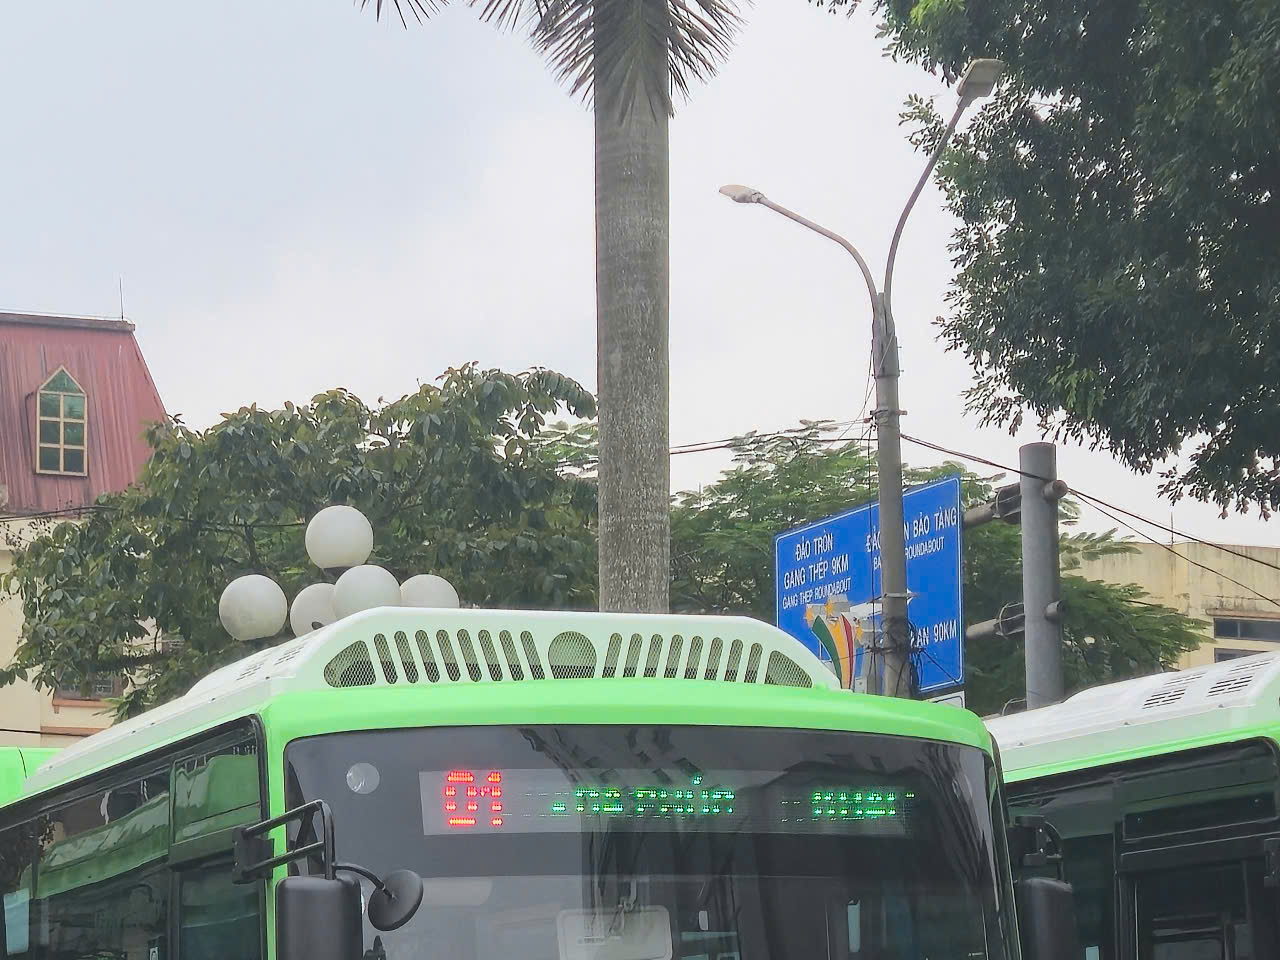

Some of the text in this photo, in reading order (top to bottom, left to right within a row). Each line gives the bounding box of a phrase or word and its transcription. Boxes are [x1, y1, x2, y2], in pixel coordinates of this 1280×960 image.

[913, 512, 929, 538] BẢO
[934, 506, 957, 531] TÀNG
[796, 530, 833, 561] ĐẢO TRÒN
[784, 554, 849, 589] GANG THÉP 9KM
[782, 578, 851, 609] GANG THEP ROUNDABOUT
[933, 619, 957, 643] 90KM
[445, 771, 503, 825] 01
